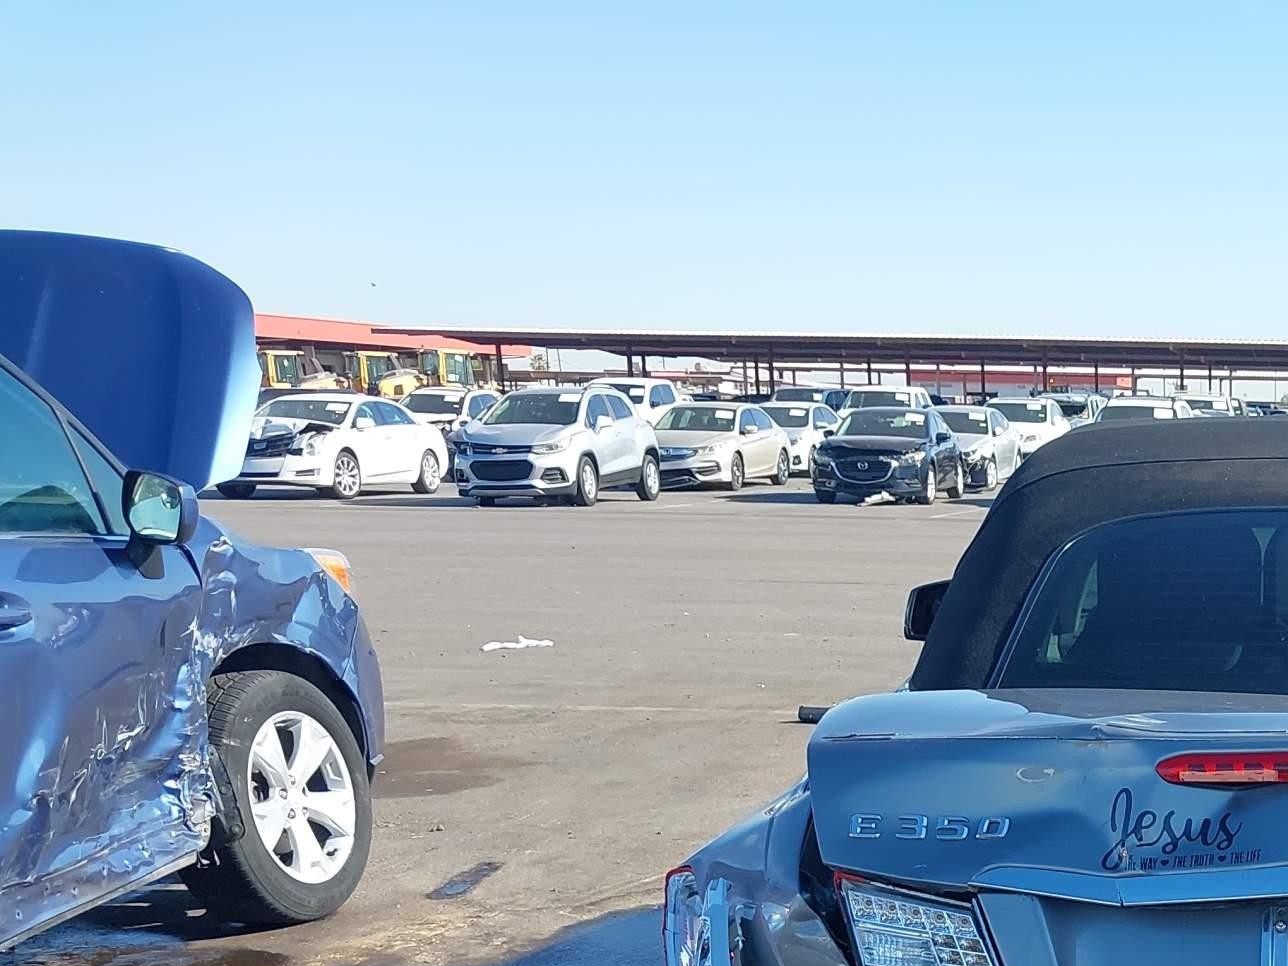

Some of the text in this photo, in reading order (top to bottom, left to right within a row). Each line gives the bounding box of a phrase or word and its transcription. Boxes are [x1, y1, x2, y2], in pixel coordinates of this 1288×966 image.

[849, 813, 1011, 841] E 350
[1101, 788, 1242, 870] Jesus
[1140, 855, 1158, 871] WAY
[1173, 855, 1188, 868] THE
[1190, 853, 1215, 868] TRUTH
[1230, 851, 1244, 865] THE
